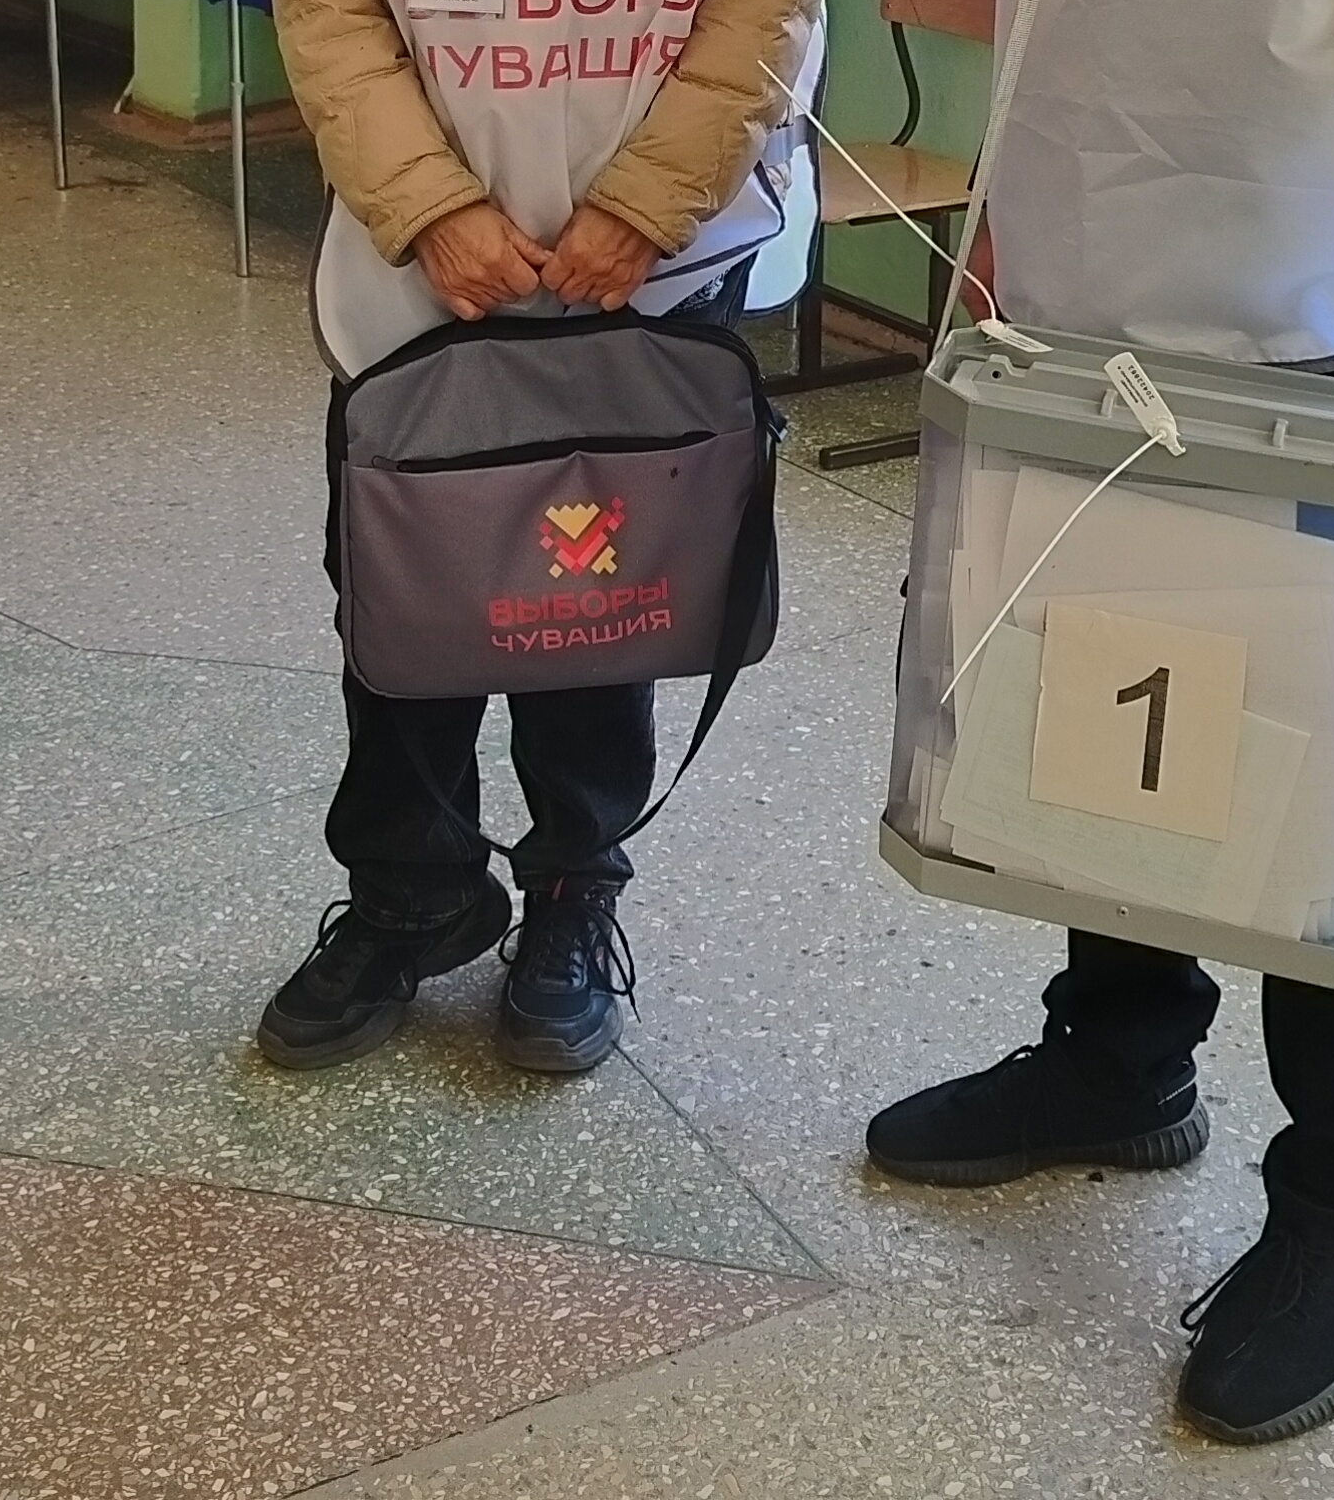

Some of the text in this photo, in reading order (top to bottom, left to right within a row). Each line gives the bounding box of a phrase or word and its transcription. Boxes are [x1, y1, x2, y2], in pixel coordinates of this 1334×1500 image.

[489, 577, 670, 627] ВЫБОРЫ
[491, 609, 672, 652] ЧУВАШИЯ
[1116, 666, 1169, 793] 1
